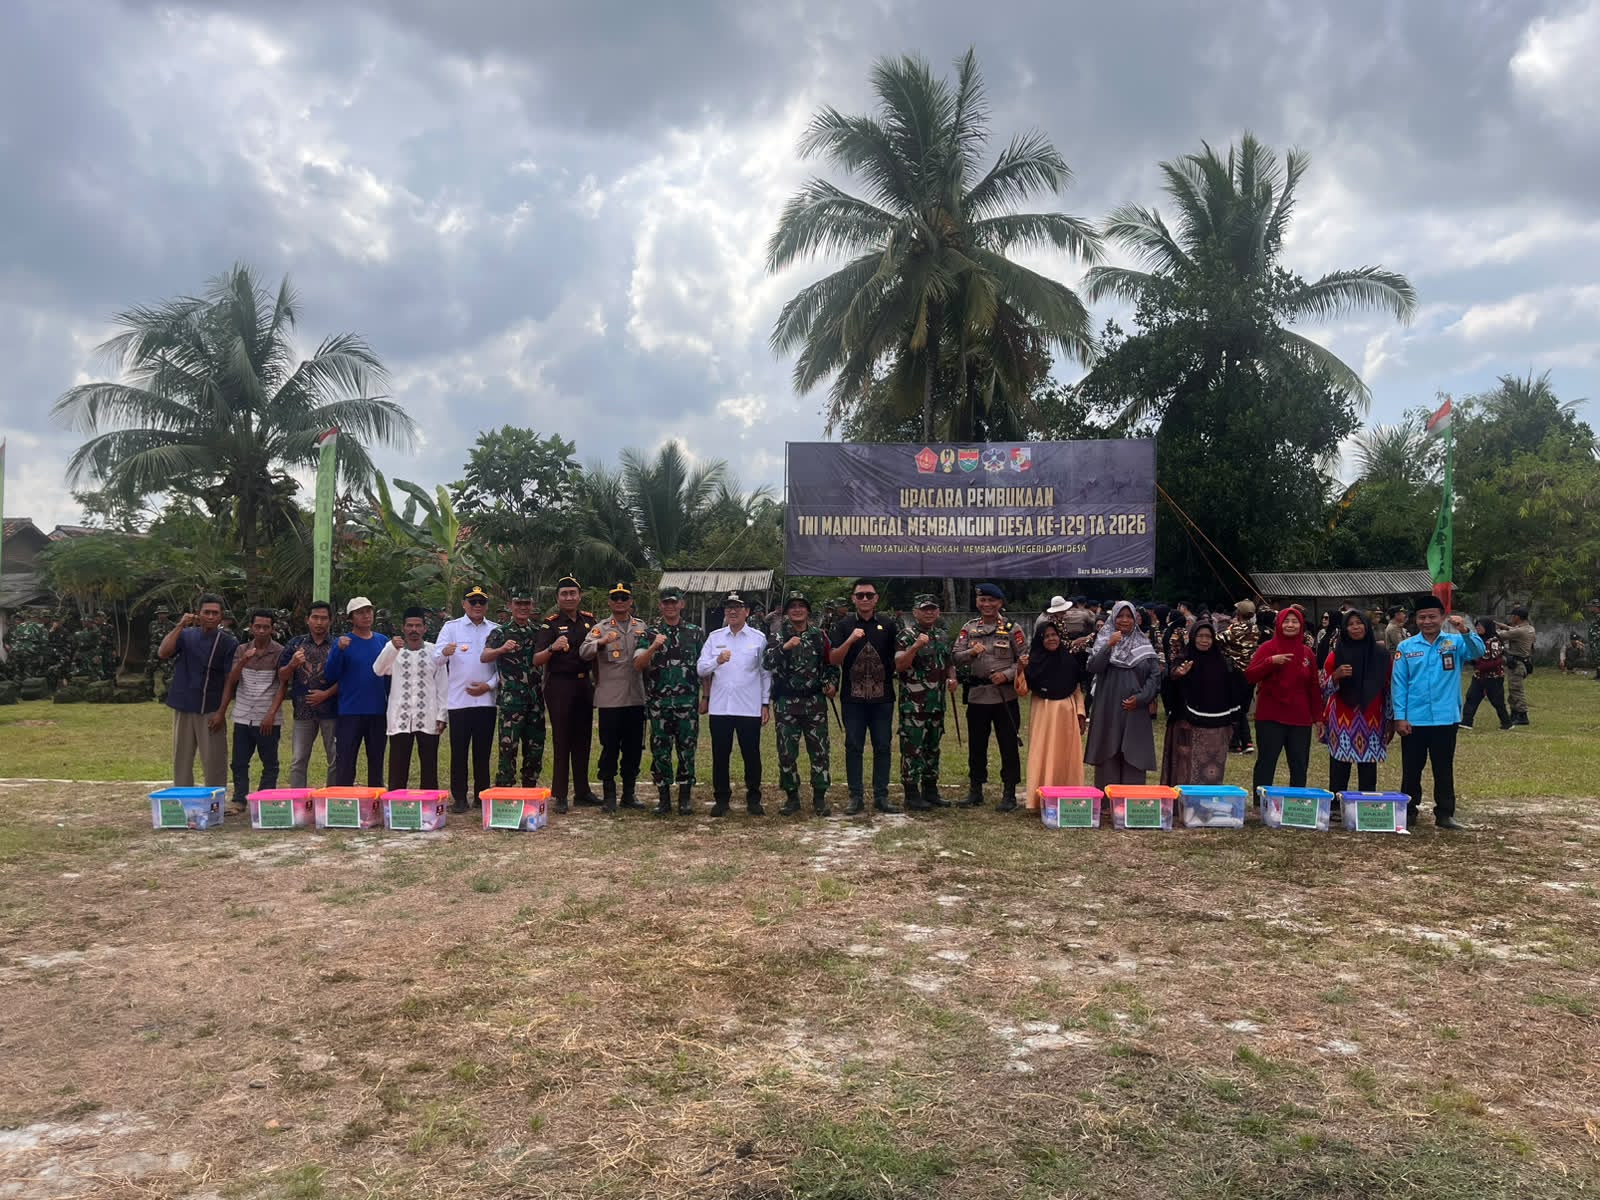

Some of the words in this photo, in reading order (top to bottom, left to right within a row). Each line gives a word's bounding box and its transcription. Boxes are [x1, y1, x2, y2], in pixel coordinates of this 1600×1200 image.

[900, 488, 963, 508] UPACARA
[967, 487, 1054, 508] PEMBUKAAN
[797, 515, 818, 536] TNI
[821, 515, 904, 537] MANUNGGAL
[907, 515, 994, 537] MEMBANGUN
[997, 515, 1033, 536] DESA
[1037, 515, 1085, 536] KE-129
[1088, 514, 1106, 535] TA
[1108, 513, 1146, 535] 2026
[860, 544, 882, 553] TMMD
[883, 544, 920, 553] SATUKAN
[921, 544, 959, 553] LANGKAH
[963, 544, 1015, 553] MEMBANGUN
[1015, 544, 1044, 553] NEGERI
[1046, 544, 1065, 553] DARI
[1066, 543, 1087, 553] DESA
